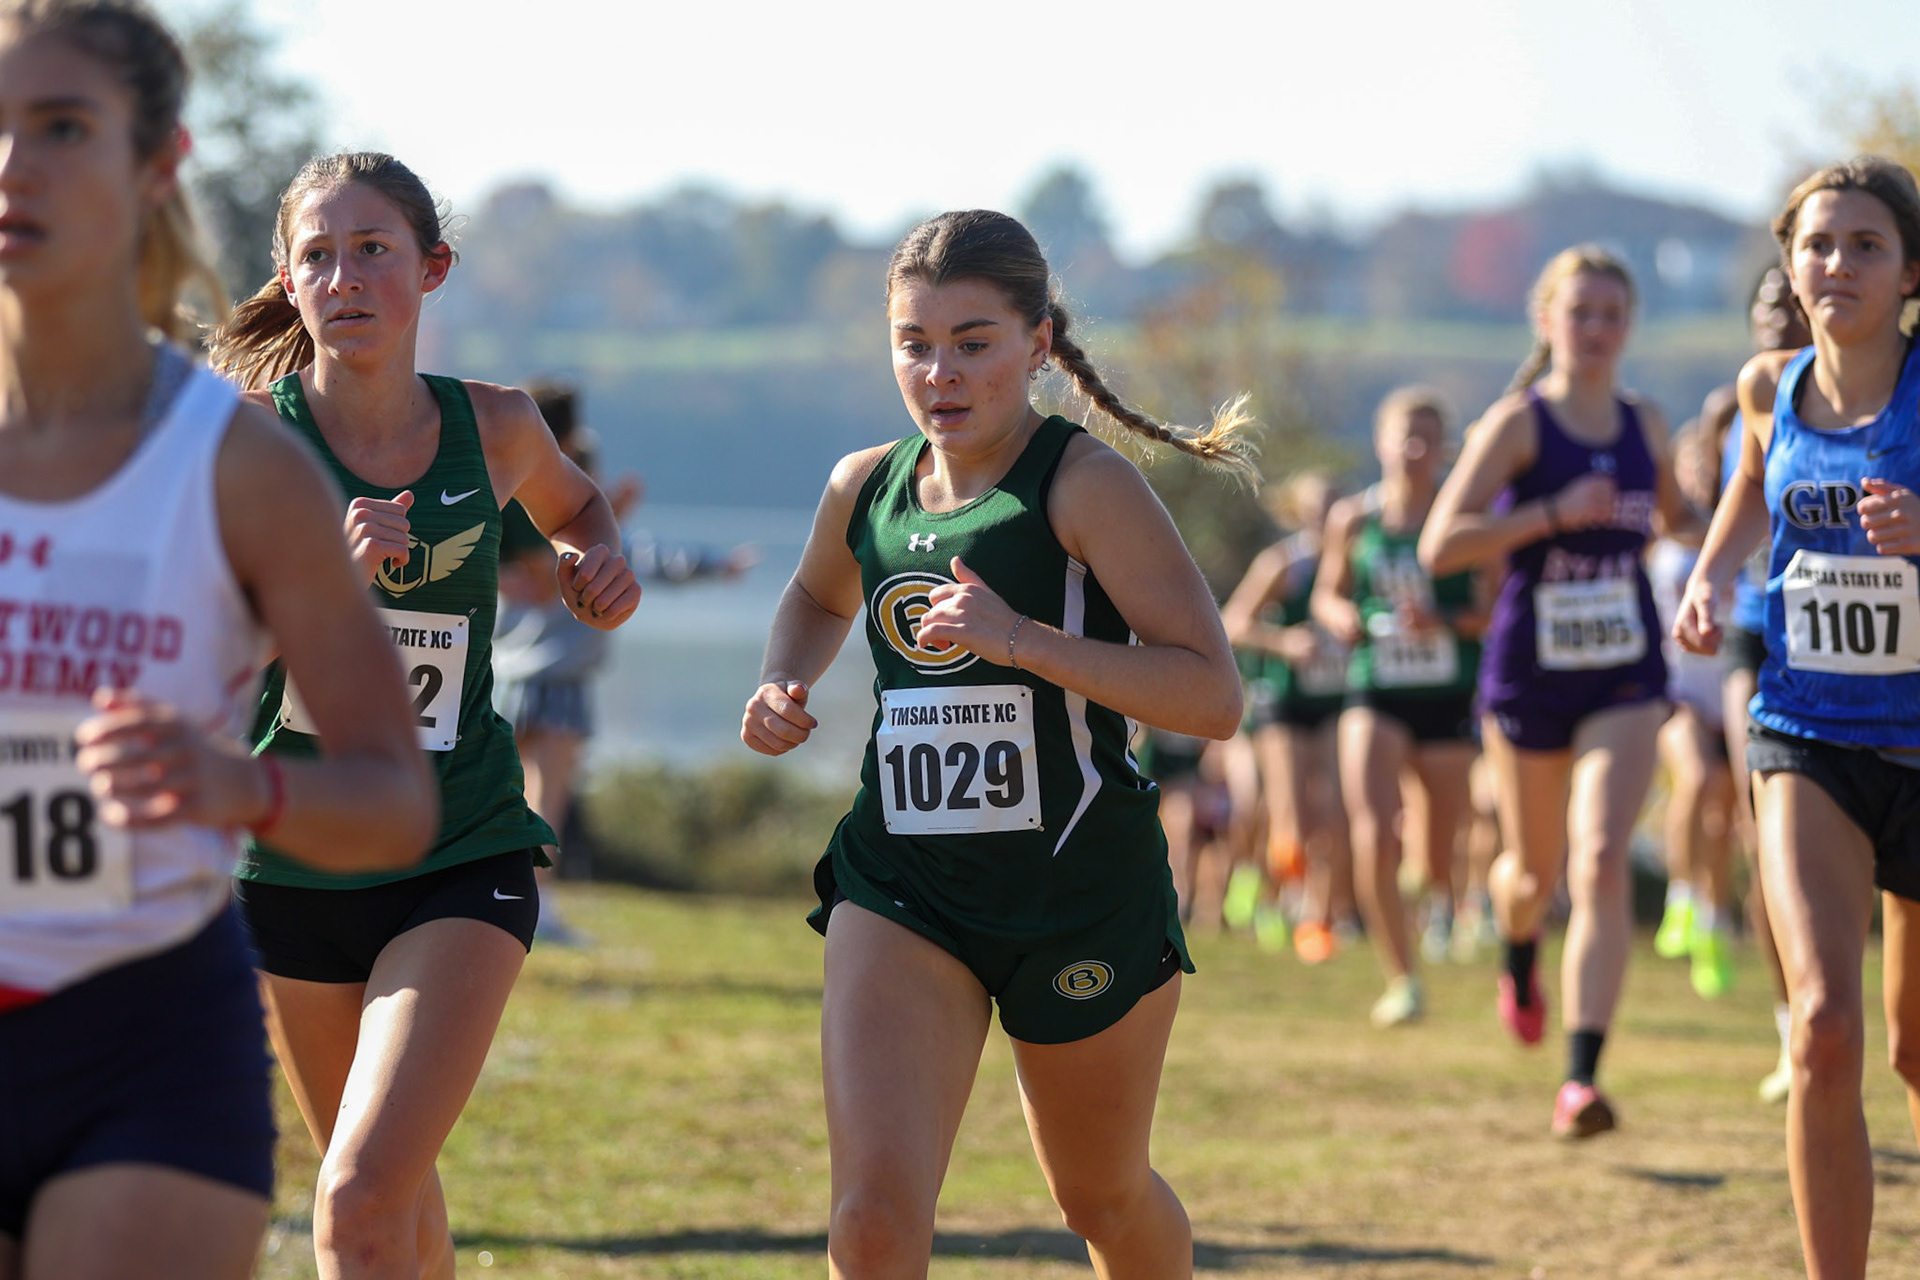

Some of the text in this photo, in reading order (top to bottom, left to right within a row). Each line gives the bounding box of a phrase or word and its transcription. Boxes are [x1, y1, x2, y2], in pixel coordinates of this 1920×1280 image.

[1841, 571, 1880, 587] STATE
[1883, 574, 1903, 588] XC
[386, 625, 452, 649] TATE XC
[1801, 598, 1900, 655] 1107
[891, 702, 1017, 726] TMSAA STATE XC
[885, 740, 1025, 812] 1029
[0, 790, 96, 881] 18
